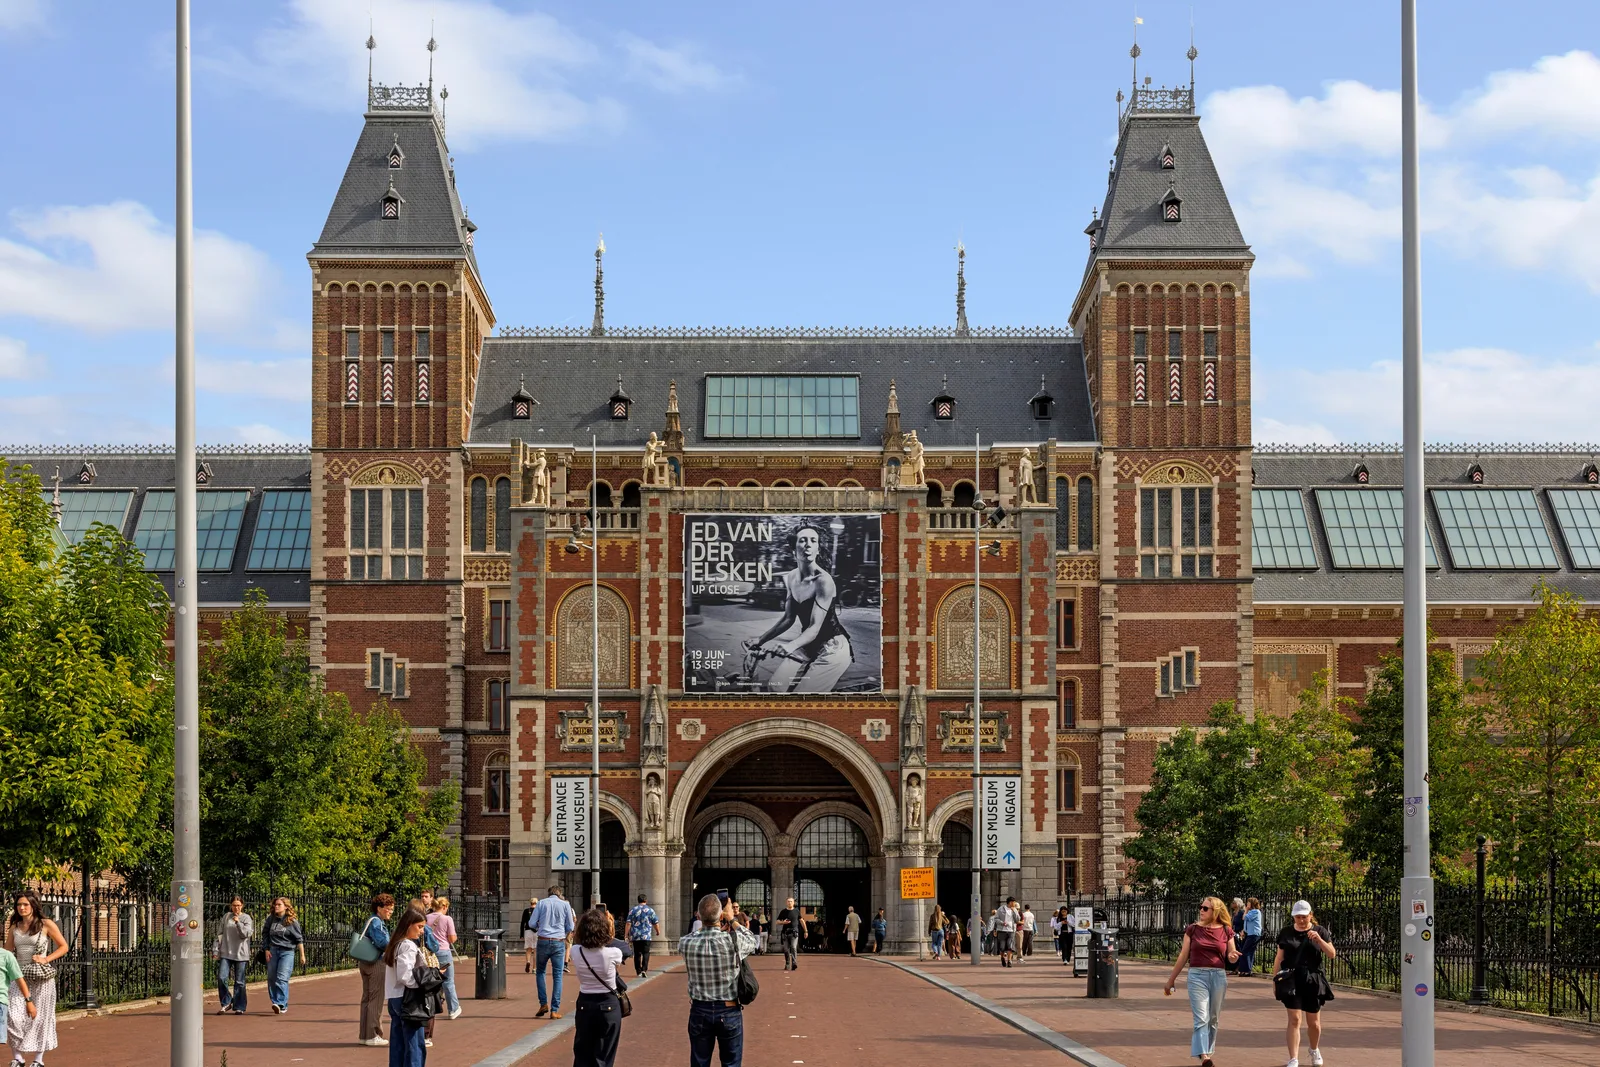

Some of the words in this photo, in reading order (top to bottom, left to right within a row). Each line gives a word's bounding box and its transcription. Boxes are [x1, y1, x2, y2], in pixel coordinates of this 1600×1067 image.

[691, 522, 720, 542] ED
[726, 522, 773, 542] VAN
[691, 542, 735, 562] DER
[691, 562, 773, 582] ELSKEN
[691, 584, 706, 595] UP
[708, 584, 740, 595] CLOSE
[691, 650, 702, 660] 19
[691, 660, 702, 670] 13
[704, 660, 723, 670] SEP
[556, 781, 567, 843] ENTRANCE
[574, 781, 585, 832] MUSEUM
[987, 780, 998, 831] MUSEUM
[1005, 781, 1016, 826] INGANG
[574, 834, 585, 865] RIJKS
[987, 834, 998, 865] RIJKS
